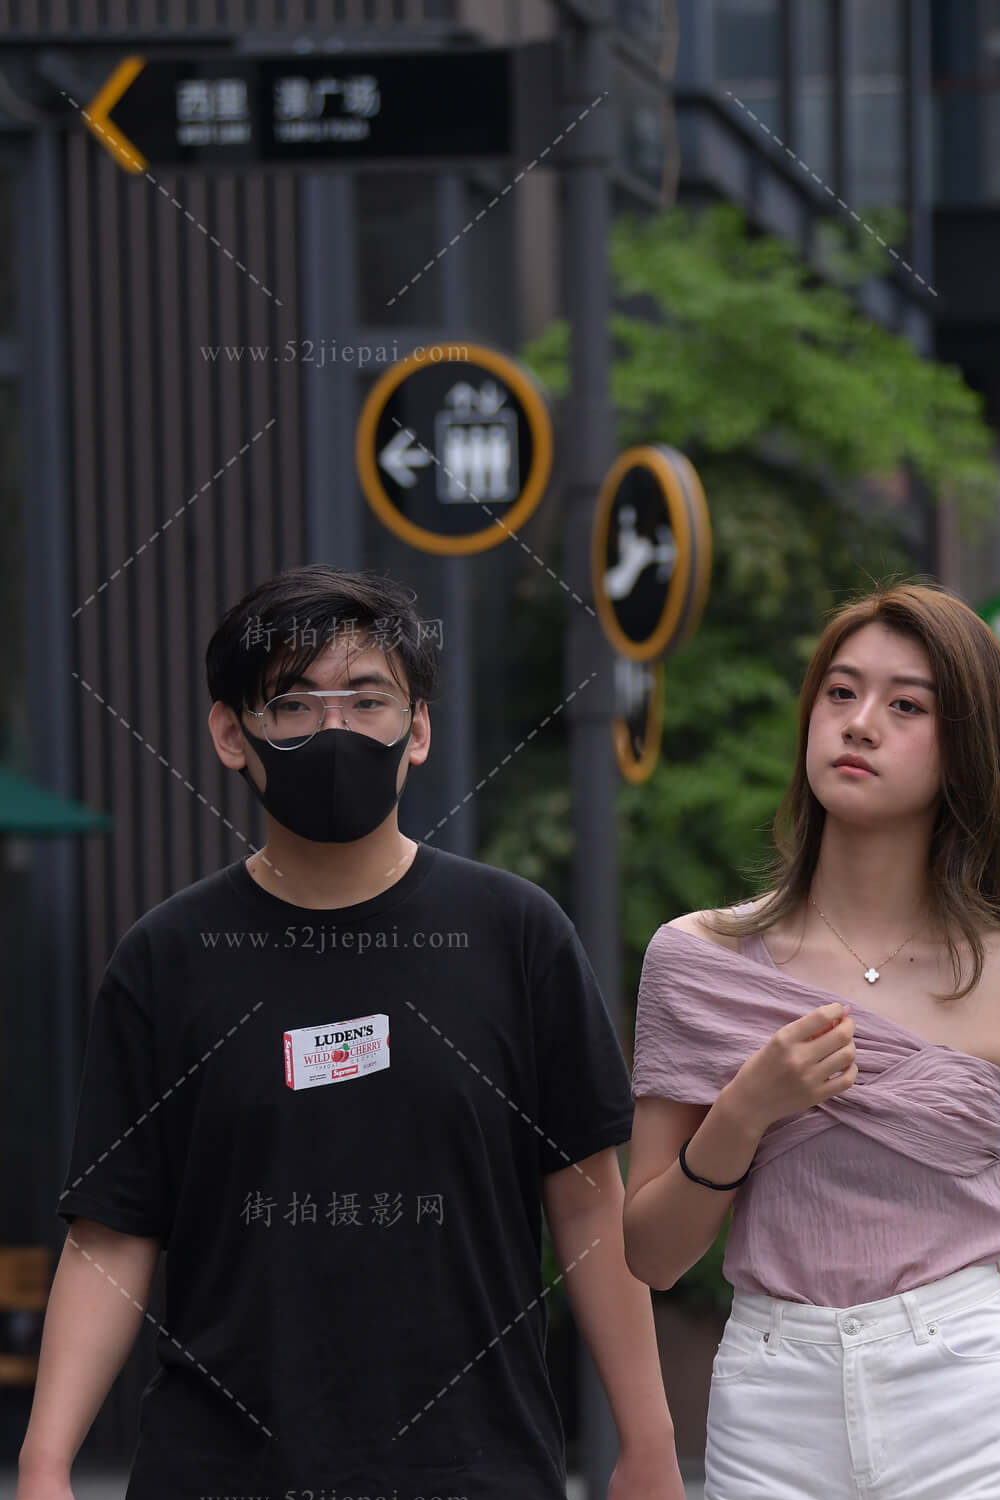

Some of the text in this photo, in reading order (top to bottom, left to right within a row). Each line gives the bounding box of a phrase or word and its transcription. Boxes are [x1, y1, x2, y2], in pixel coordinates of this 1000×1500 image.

[314, 1025, 373, 1047] LUDEN'S
[304, 1053, 330, 1065] WILD
[350, 1040, 382, 1057] CHERRY
